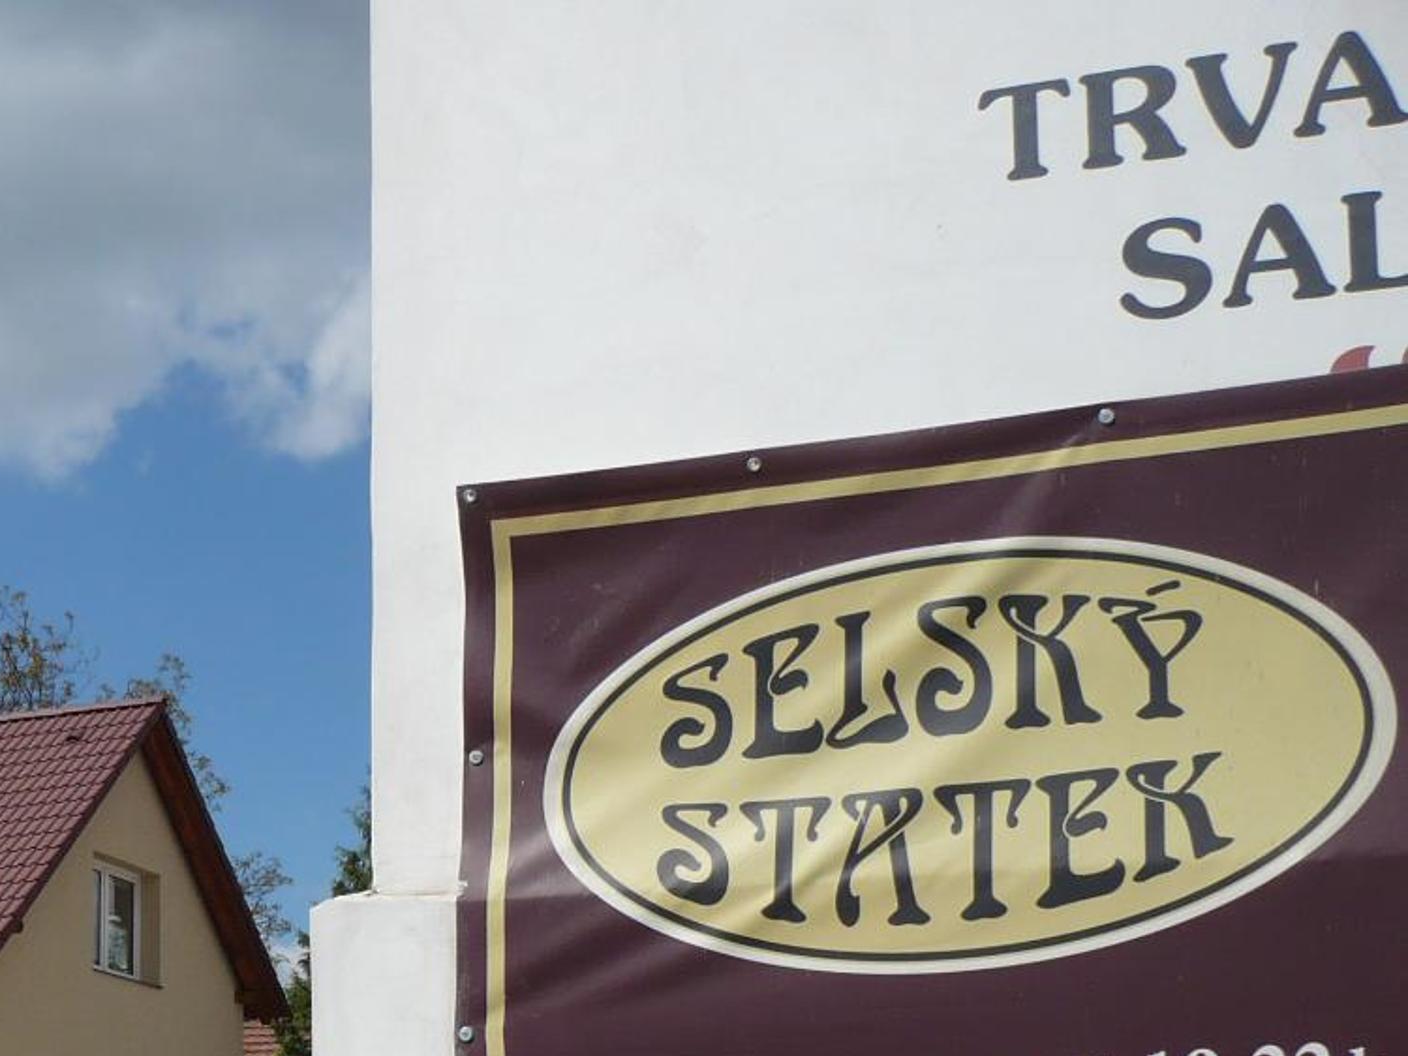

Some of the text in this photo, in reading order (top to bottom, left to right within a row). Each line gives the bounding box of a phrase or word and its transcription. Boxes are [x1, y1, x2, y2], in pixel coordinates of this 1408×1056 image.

[978, 30, 1408, 181] TRVA
[1119, 190, 1408, 320] SAL
[659, 580, 1204, 769] SELSKÝ
[656, 751, 1234, 928] STATEK
